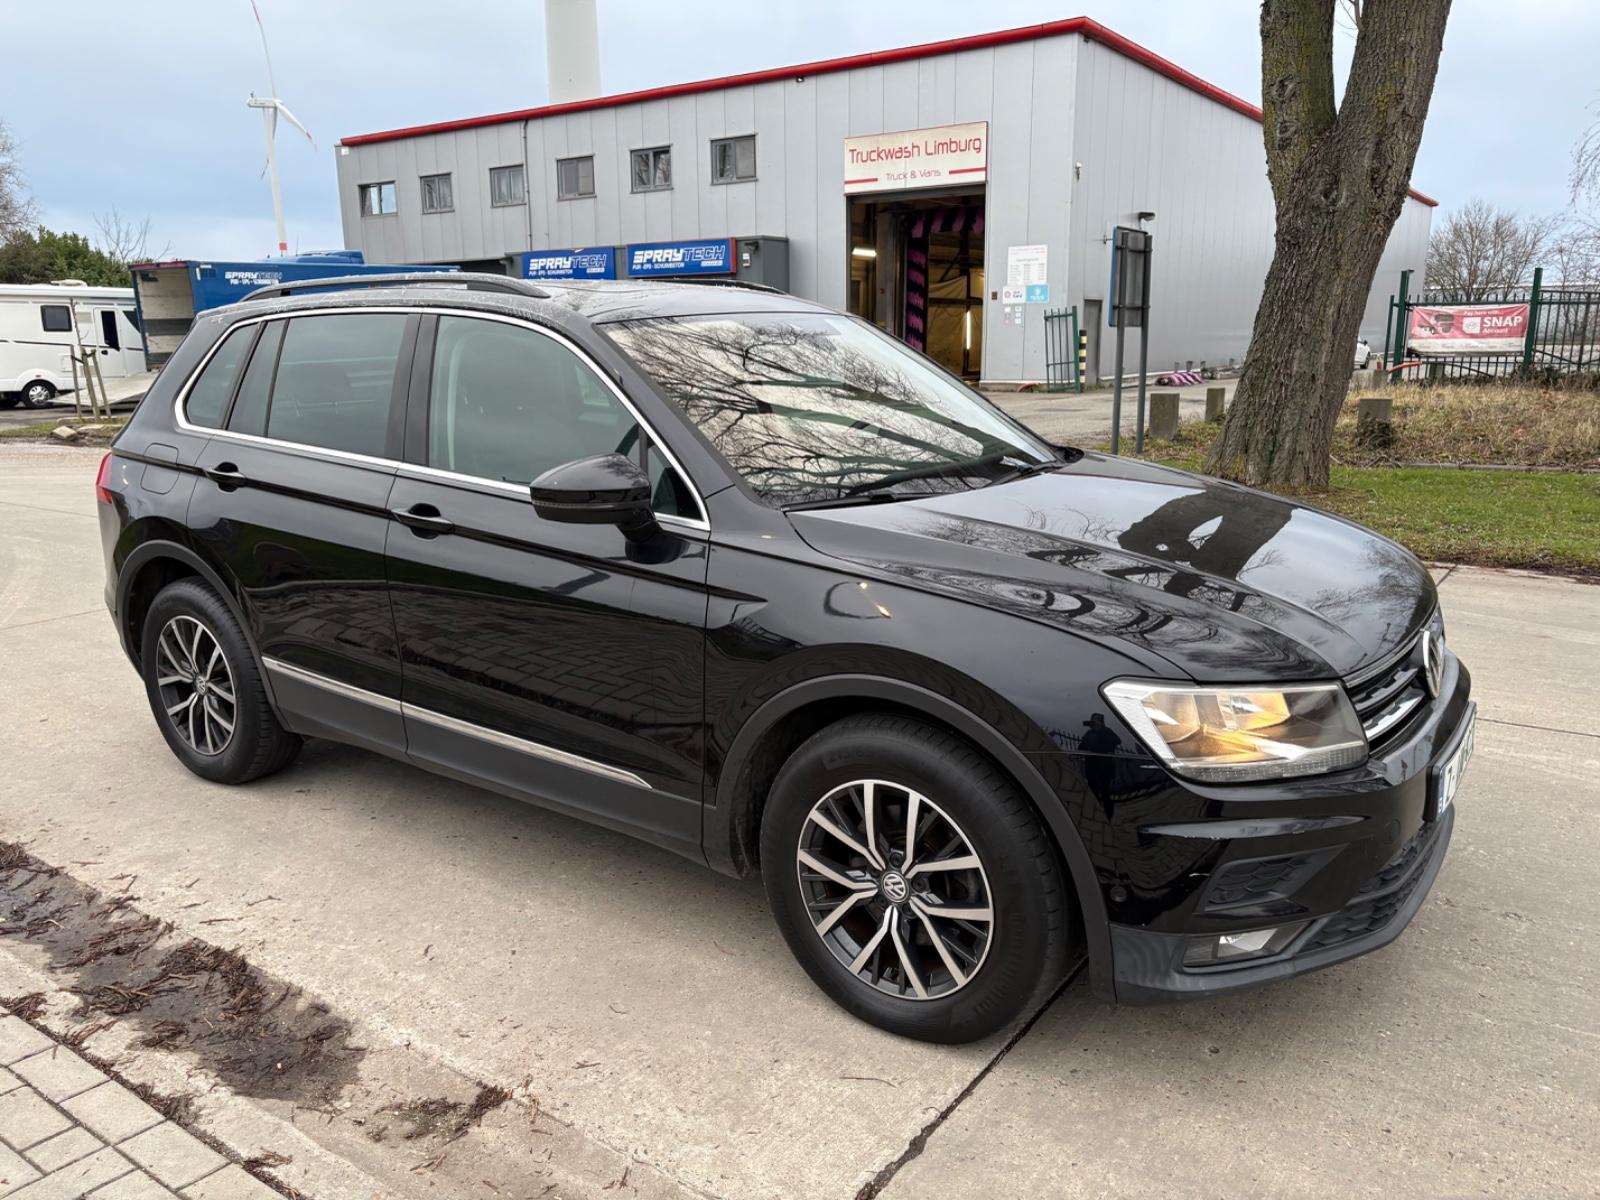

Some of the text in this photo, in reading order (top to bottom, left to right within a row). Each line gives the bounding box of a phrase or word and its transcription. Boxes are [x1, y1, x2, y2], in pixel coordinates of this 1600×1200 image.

[849, 137, 982, 164] Truckwash Limburg
[886, 168, 942, 181] Truck & Vans
[529, 254, 607, 270] SPRAYTECH
[633, 245, 726, 264] SPRAYTECH
[1482, 315, 1523, 327] SNAP
